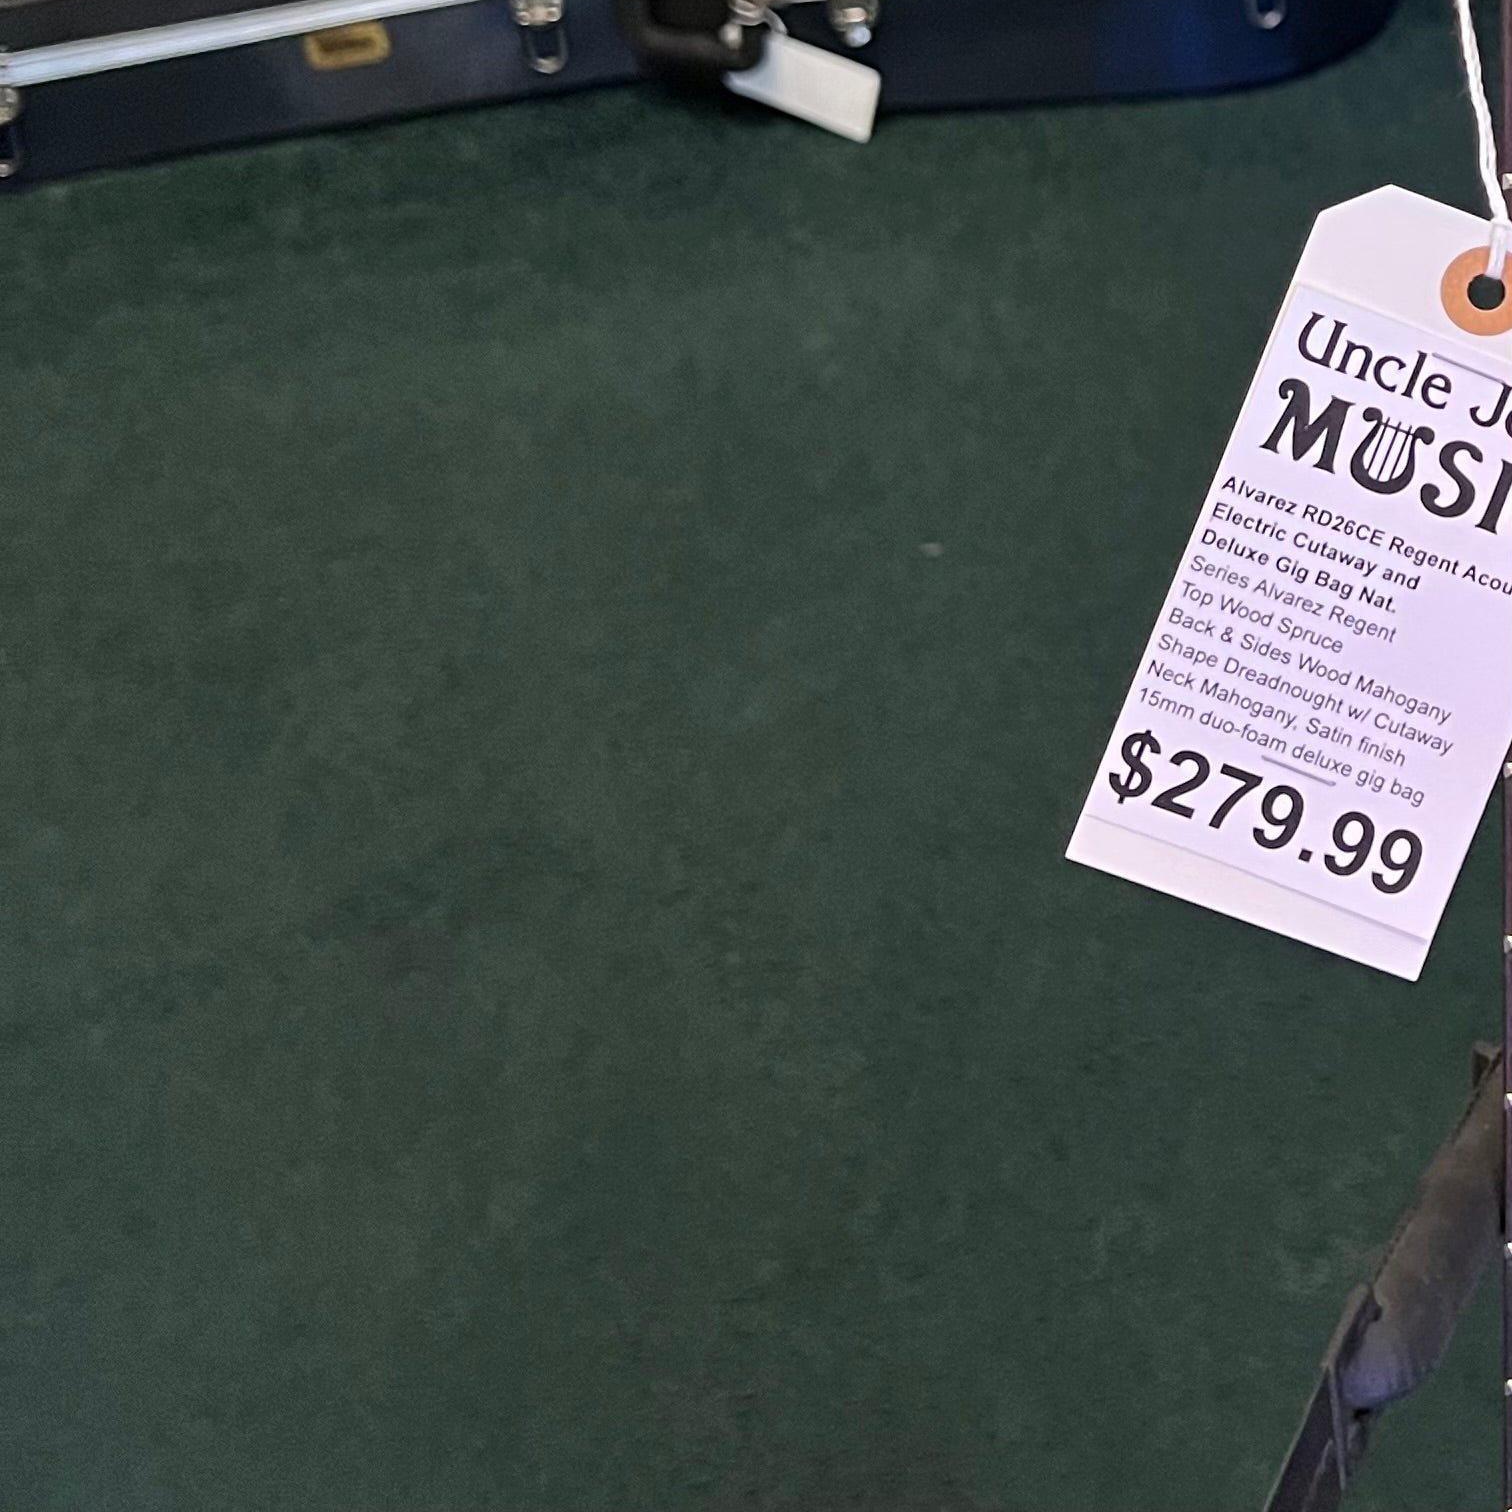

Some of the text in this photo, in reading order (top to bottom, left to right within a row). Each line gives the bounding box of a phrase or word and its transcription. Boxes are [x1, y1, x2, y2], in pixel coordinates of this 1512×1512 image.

[1298, 312, 1452, 410] Uncle
[1200, 528, 1395, 613] Deluxe Gig Bag Nat.
[1212, 502, 1421, 590] Electric Cutaway and
[1221, 476, 1297, 515] Alvarez
[1302, 504, 1385, 547] RD26CE
[1388, 536, 1459, 575] Regent
[1183, 580, 1343, 654] Top Wood Spruce
[1190, 555, 1397, 643] Series Alvarez Regent
[1147, 659, 1406, 767] Neck Mahogany, Satin finish
[1158, 633, 1454, 757] Shape Dreadnought w/ Cutaway
[1168, 607, 1452, 726] Back & Sides Wood Mahogany
[1140, 687, 1425, 808] 15mm duo-foam deluxe gig bag
[1108, 730, 1423, 894] $279.99
